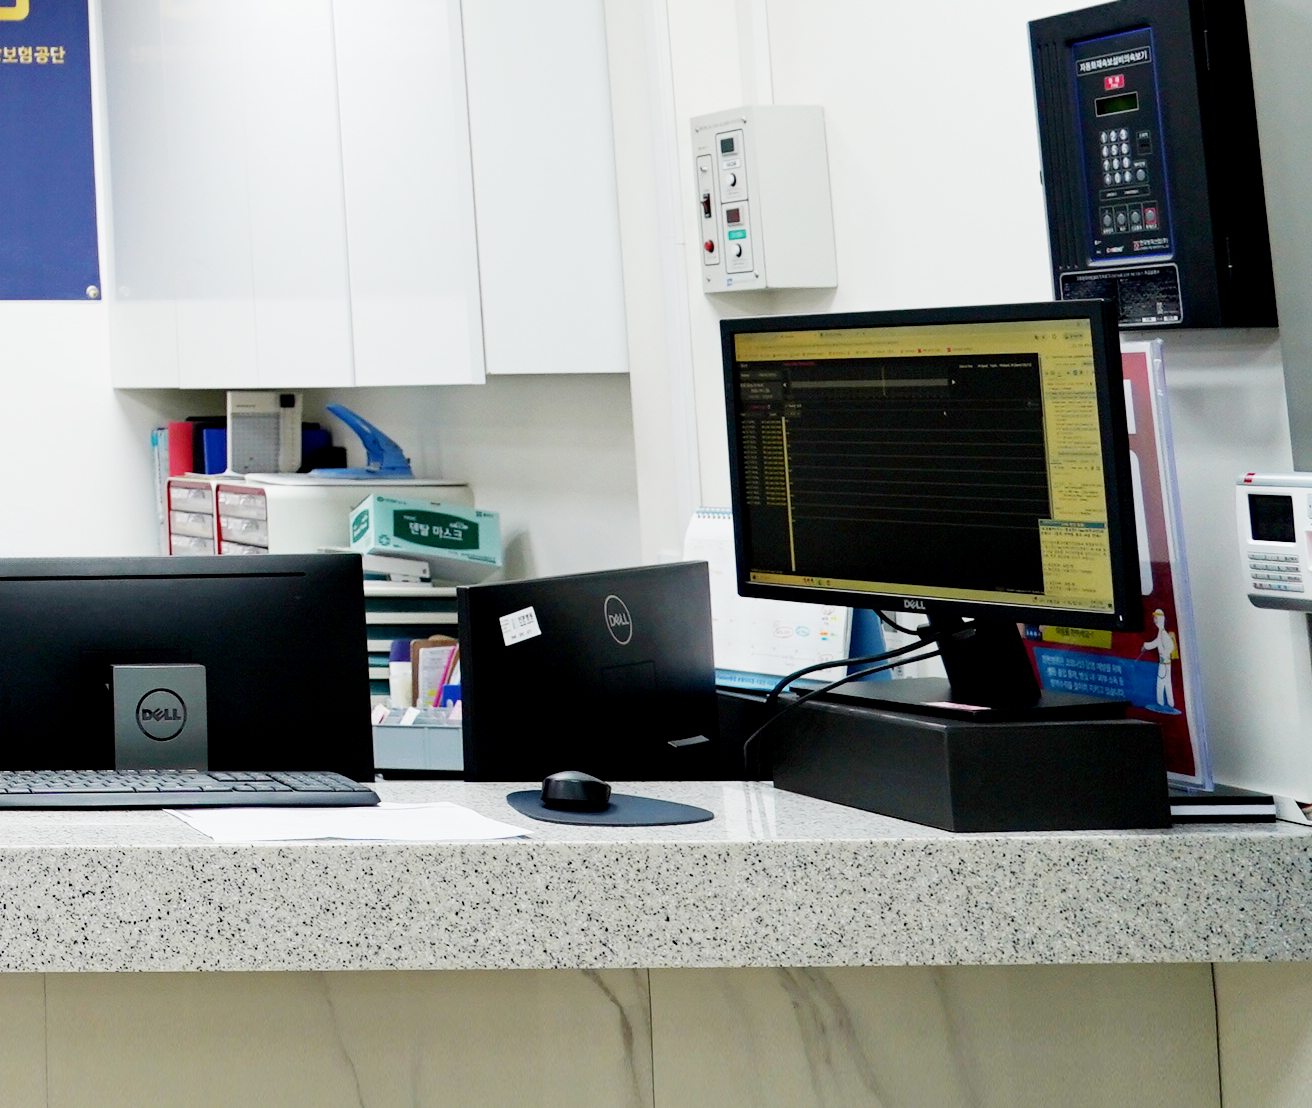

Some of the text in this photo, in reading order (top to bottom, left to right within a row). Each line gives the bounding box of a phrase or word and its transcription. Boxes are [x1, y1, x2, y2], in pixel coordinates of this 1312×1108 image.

[409, 521, 430, 537] 덴탈
[432, 524, 464, 541] 마스크
[903, 599, 926, 610] DELL
[609, 614, 629, 627] DELL
[141, 708, 181, 722] DELL
